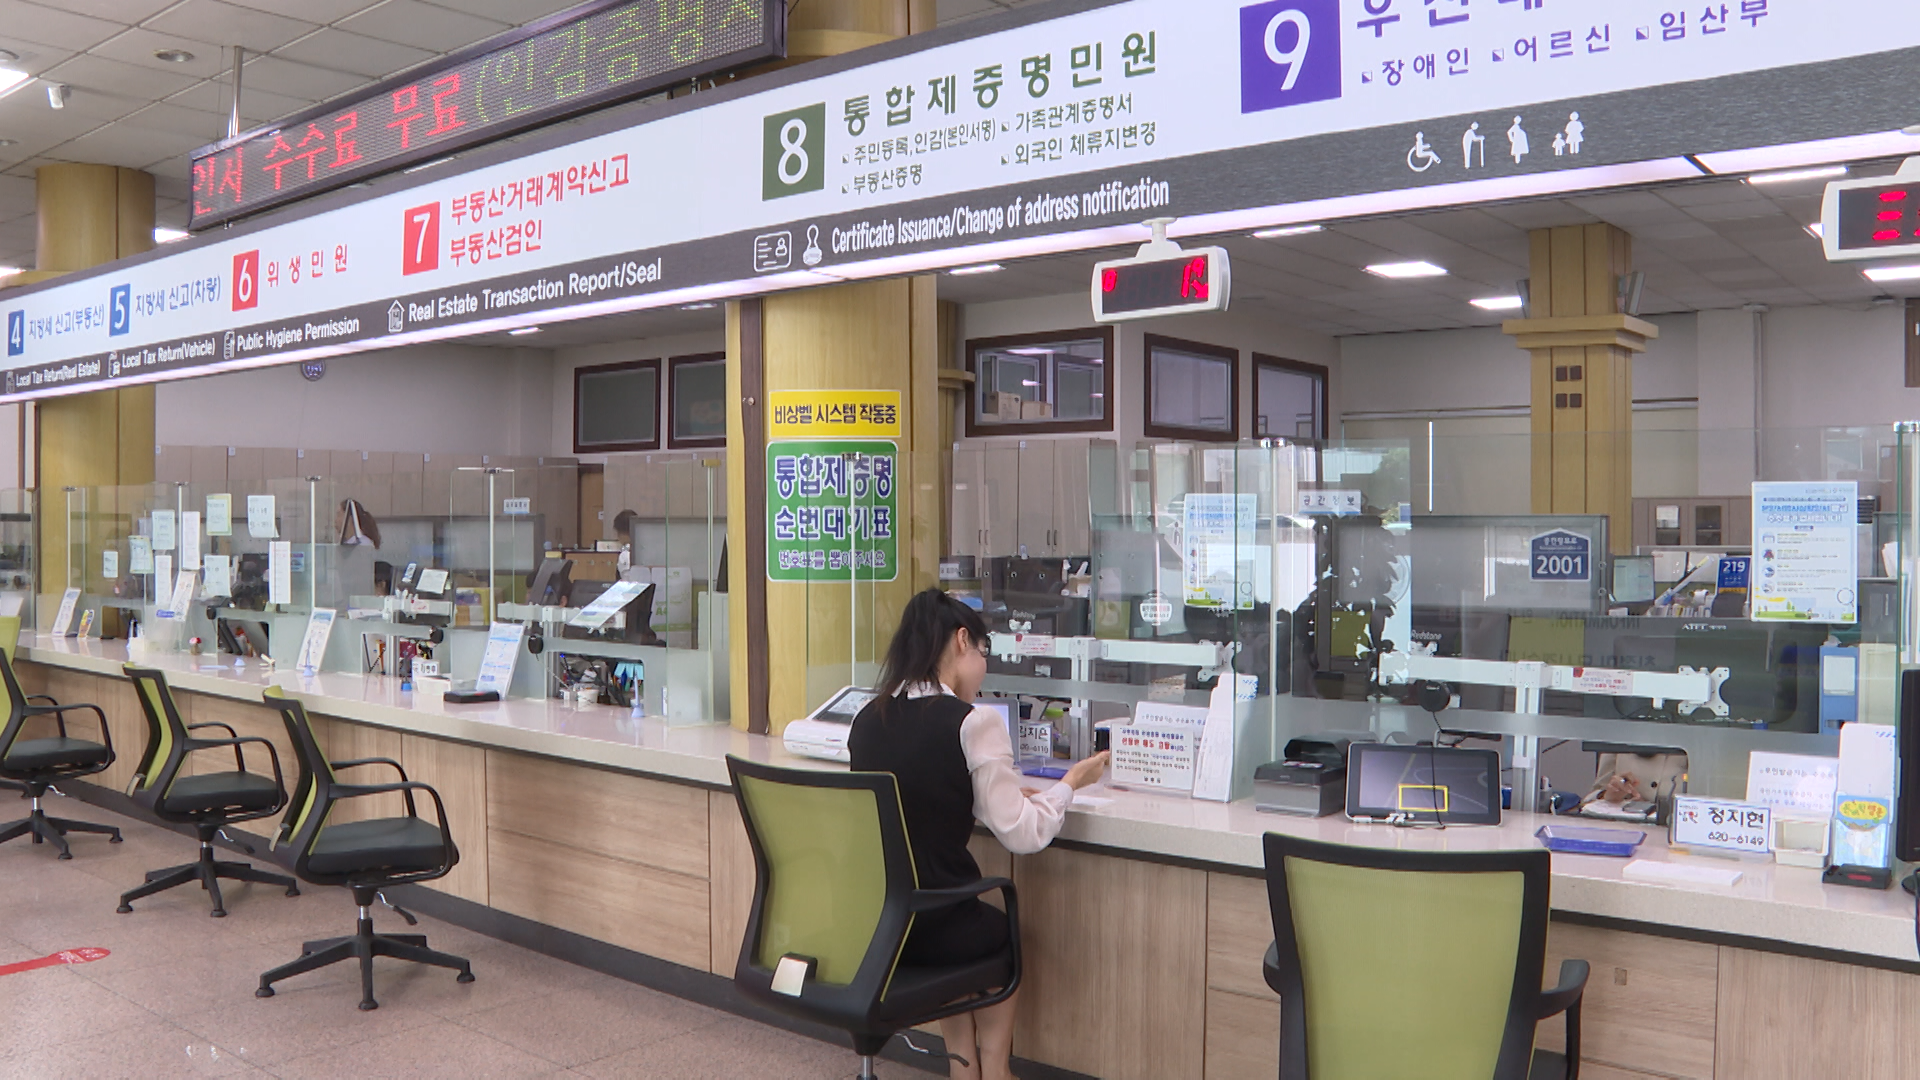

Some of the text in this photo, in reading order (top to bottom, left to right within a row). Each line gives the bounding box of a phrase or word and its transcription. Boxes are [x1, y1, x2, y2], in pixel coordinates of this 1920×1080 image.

[1659, 0, 1769, 41] 임산부
[1263, 10, 1311, 91] 9
[1513, 24, 1611, 61] 어르신
[1381, 47, 1470, 86] 장애인
[1015, 92, 1133, 133] 가족관계증명서
[263, 112, 363, 190] 수수료
[777, 118, 809, 186] 8
[1014, 121, 1156, 166] 외국인 체류지변경
[451, 153, 629, 226] 부동산거래계약신고
[853, 163, 923, 196] 부동산증명
[832, 179, 1169, 255] Certificate Issuance/Change of address notification
[413, 211, 431, 264] 7
[450, 219, 543, 267] 부동산검인
[238, 258, 253, 302] 6
[408, 257, 662, 322] Real Estate Transaction Report/Seal
[114, 291, 126, 329] 5
[136, 287, 165, 317] 지방세
[11, 316, 20, 349] 4
[237, 315, 359, 352] Public Hygiene Permission
[121, 337, 216, 369] Local Tax Return(Vehicle)
[16, 371, 31, 387] Local
[32, 370, 43, 384] Tax
[775, 403, 896, 424] 비상벨 시스템 작동중
[775, 453, 893, 499] 통합제증명
[775, 505, 891, 540] 순번대기표
[1536, 555, 1582, 575] 2001
[1723, 561, 1746, 573] 219
[1708, 807, 1764, 829] 정지현
[1708, 831, 1765, 846] 620-6149
